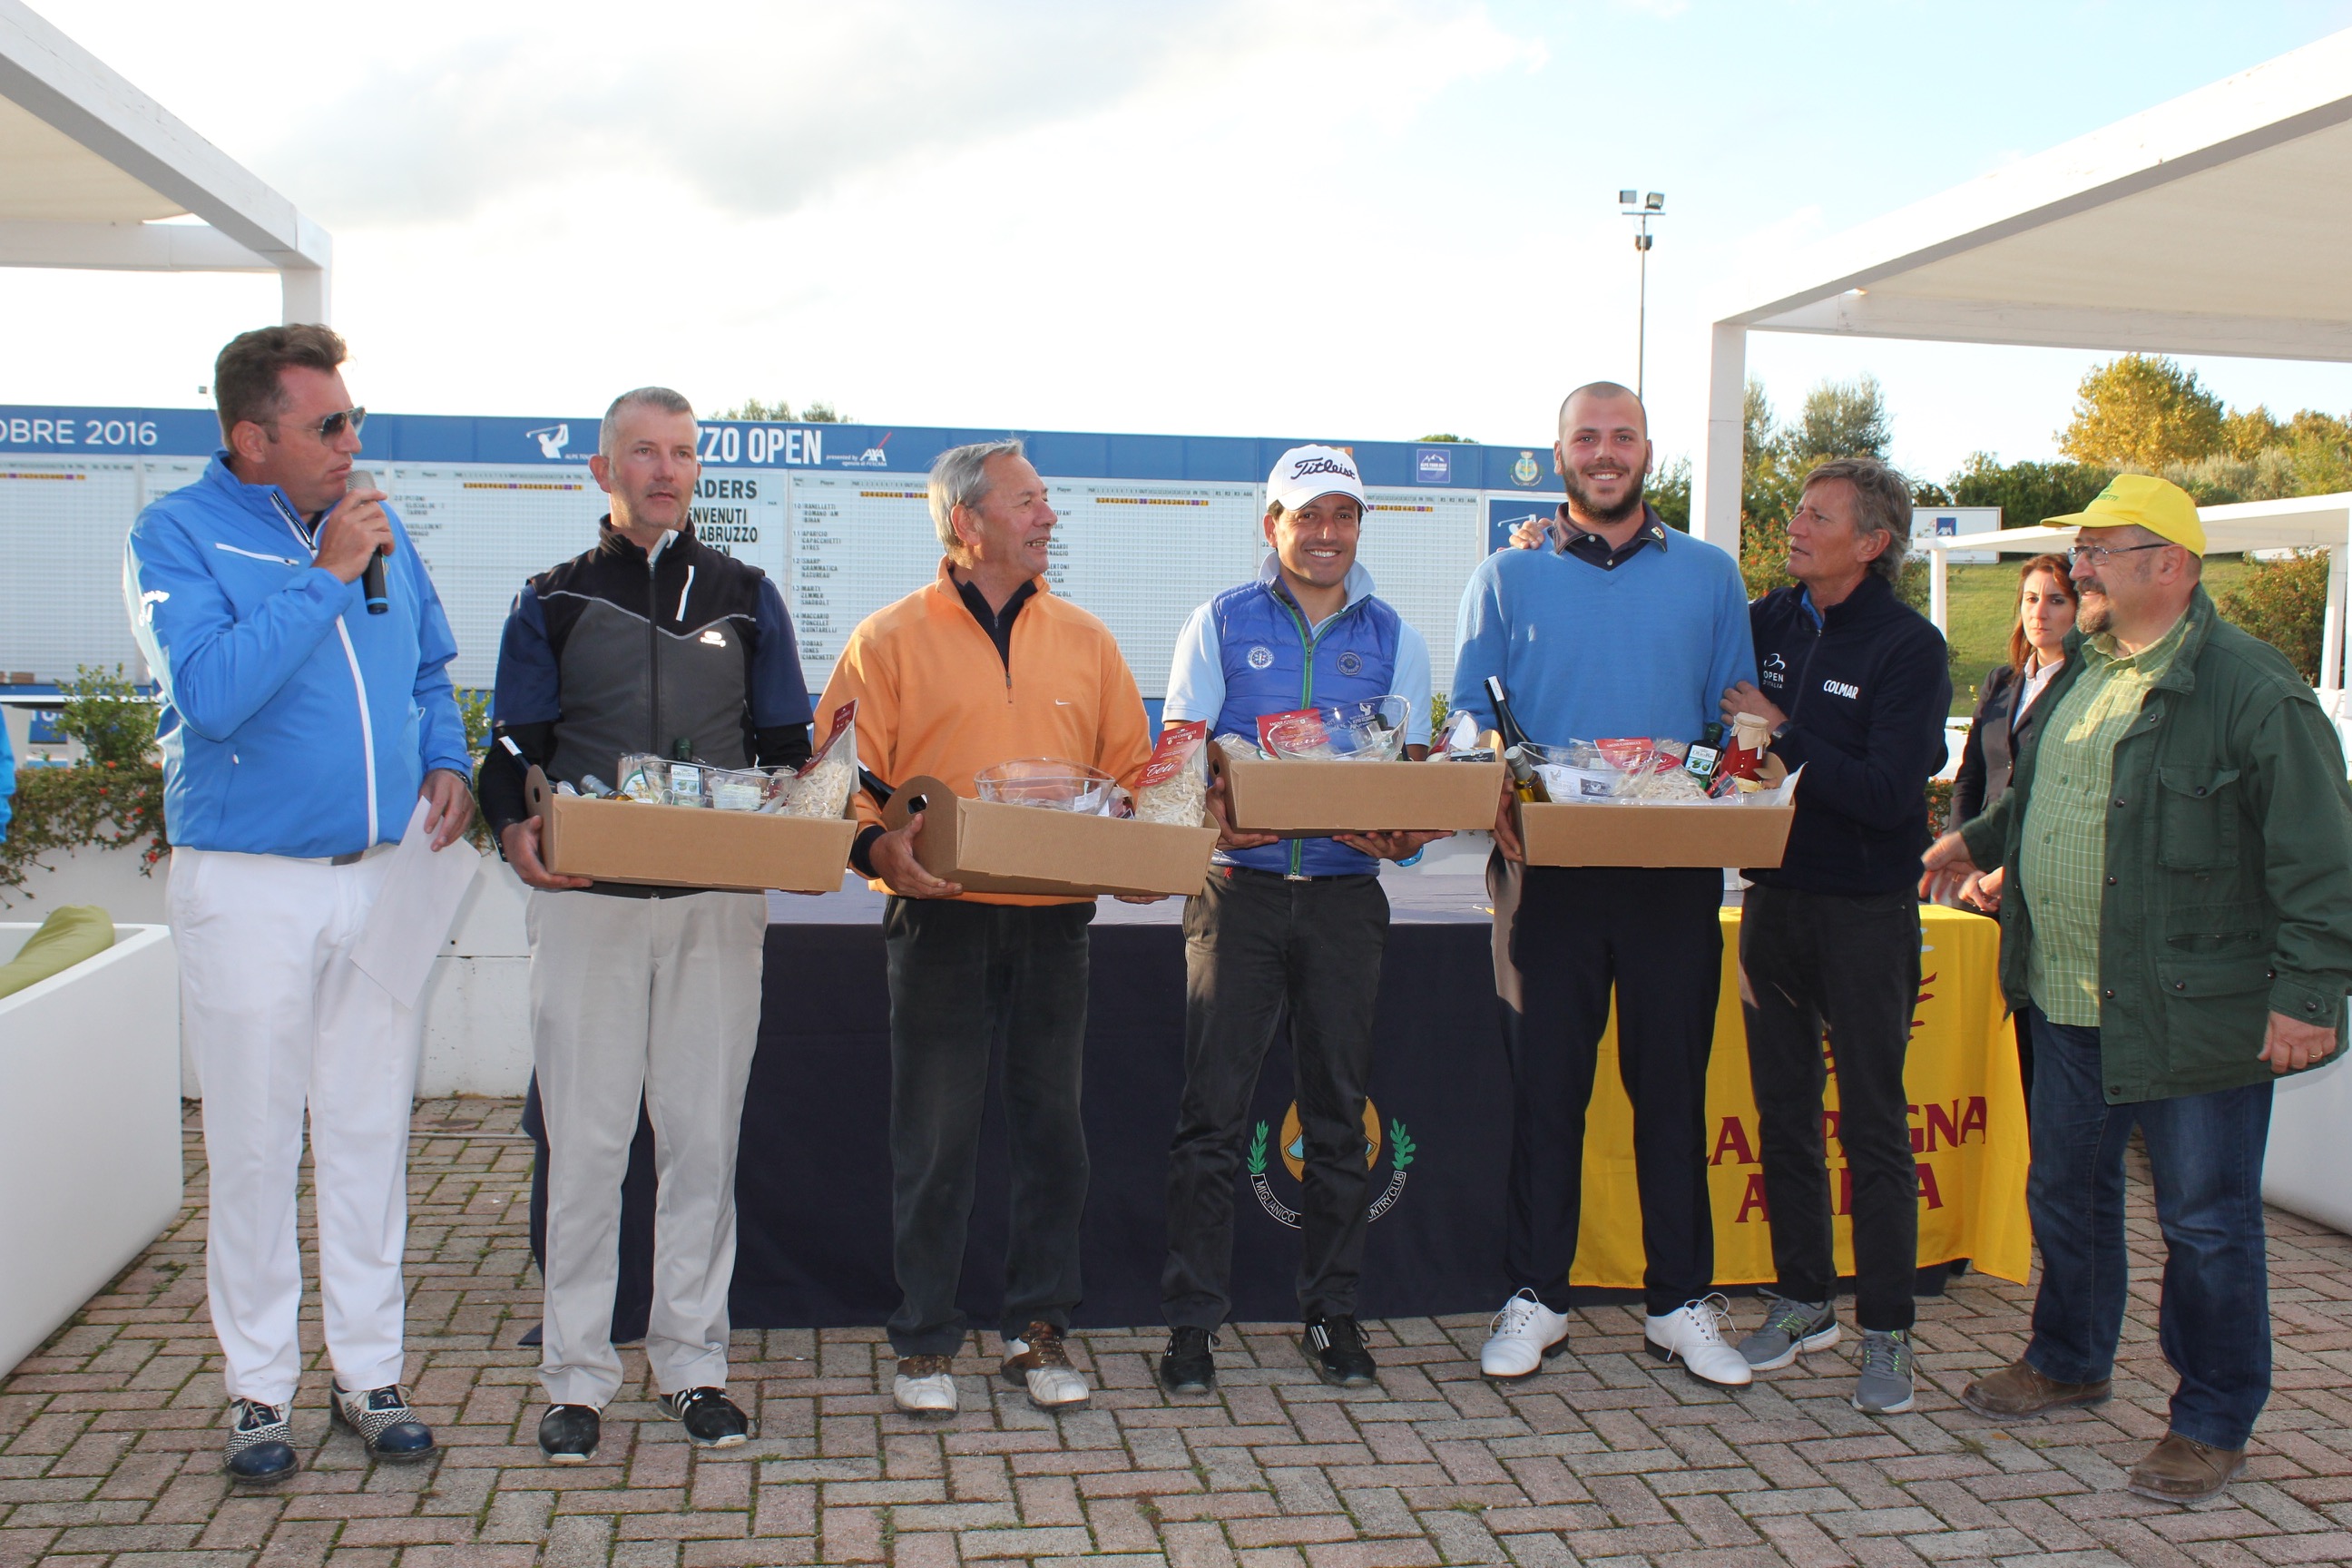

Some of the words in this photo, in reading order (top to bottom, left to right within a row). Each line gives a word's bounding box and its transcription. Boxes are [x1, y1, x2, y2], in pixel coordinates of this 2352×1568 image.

[84, 420, 158, 446] 2016
[748, 427, 821, 465] OPEN
[859, 448, 887, 462] AXA
[1290, 456, 1356, 480] Titleist
[689, 507, 747, 524] NVENUTI
[1936, 526, 1953, 535] AXA
[1763, 671, 1784, 682] OPEN
[1823, 680, 1859, 700] COLMAR
[1255, 1181, 1296, 1223] MIGLIANICO
[1388, 1172, 1405, 1197] CLUB
